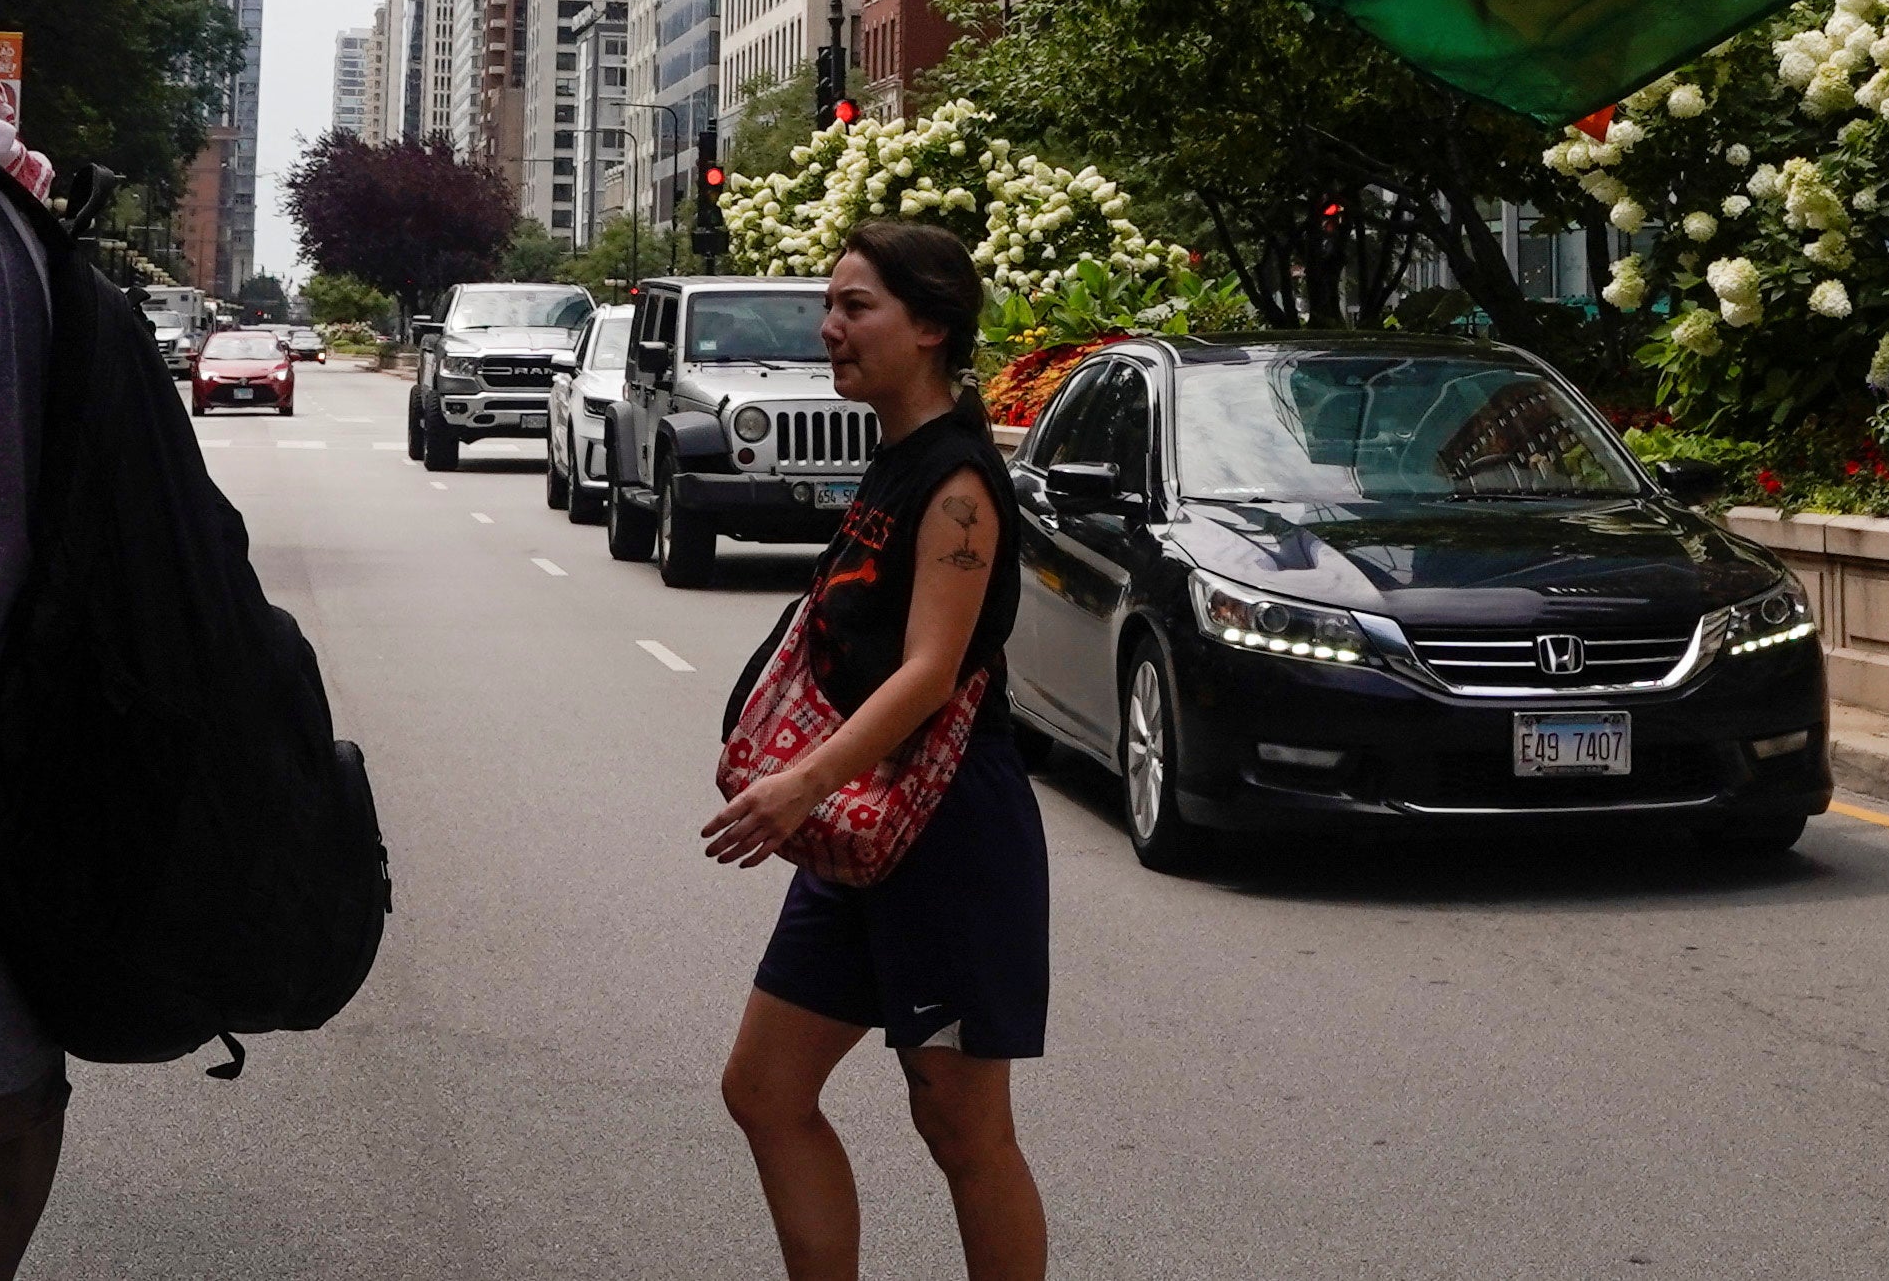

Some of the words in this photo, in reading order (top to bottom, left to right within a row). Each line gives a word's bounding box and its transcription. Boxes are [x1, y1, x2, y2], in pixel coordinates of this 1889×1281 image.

[818, 490, 836, 503] 654
[1521, 733, 1559, 763] E49
[1573, 732, 1623, 763] 7407
